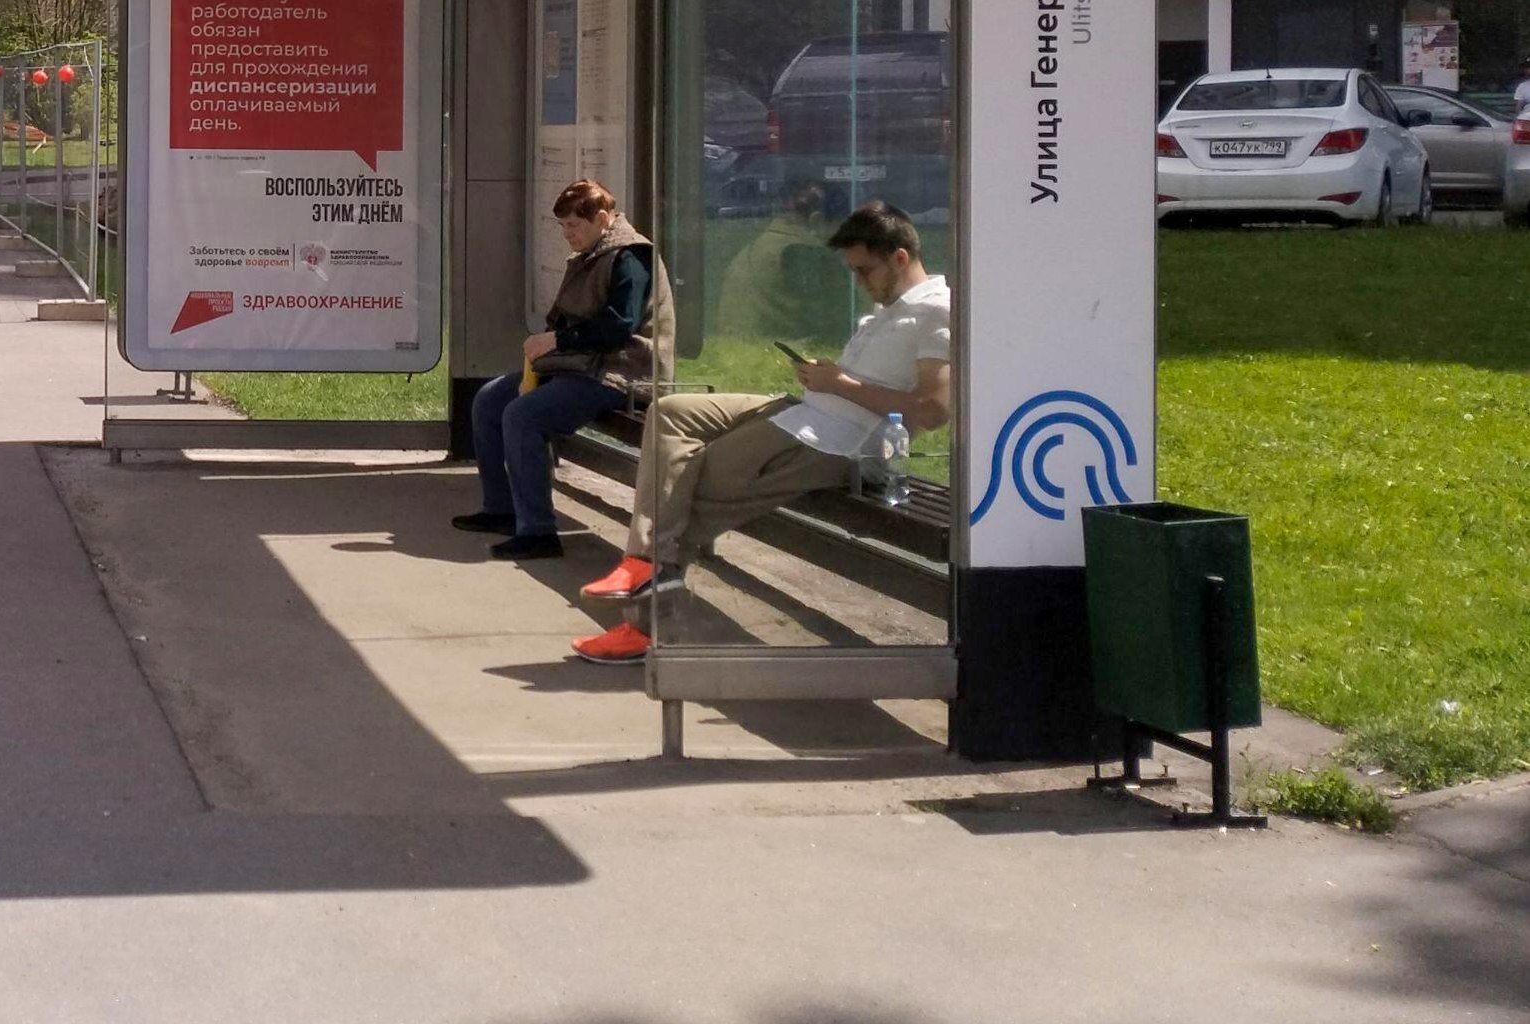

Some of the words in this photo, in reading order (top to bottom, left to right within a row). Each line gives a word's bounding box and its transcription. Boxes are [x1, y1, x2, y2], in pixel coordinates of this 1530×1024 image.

[191, 3, 328, 21] работодатель
[190, 21, 260, 38] обязан
[191, 42, 329, 59] предоставить
[189, 62, 226, 76] для
[232, 63, 368, 77] прохождения
[189, 81, 377, 97] диспансеризации
[190, 98, 340, 113] оплачиваемый
[189, 118, 242, 132] день.
[1030, 98, 1062, 205] Улица
[265, 174, 404, 197] ВОСПОЛЬЗУЙТЕСЬ
[312, 203, 354, 222] ЭТИМ
[358, 201, 403, 224] ДНЁМ
[189, 246, 246, 256] Заботьтесь
[258, 247, 290, 256] своём
[194, 258, 243, 267] здоровье
[243, 294, 403, 311] ЗДРАВООХРАНЕНИЕ
